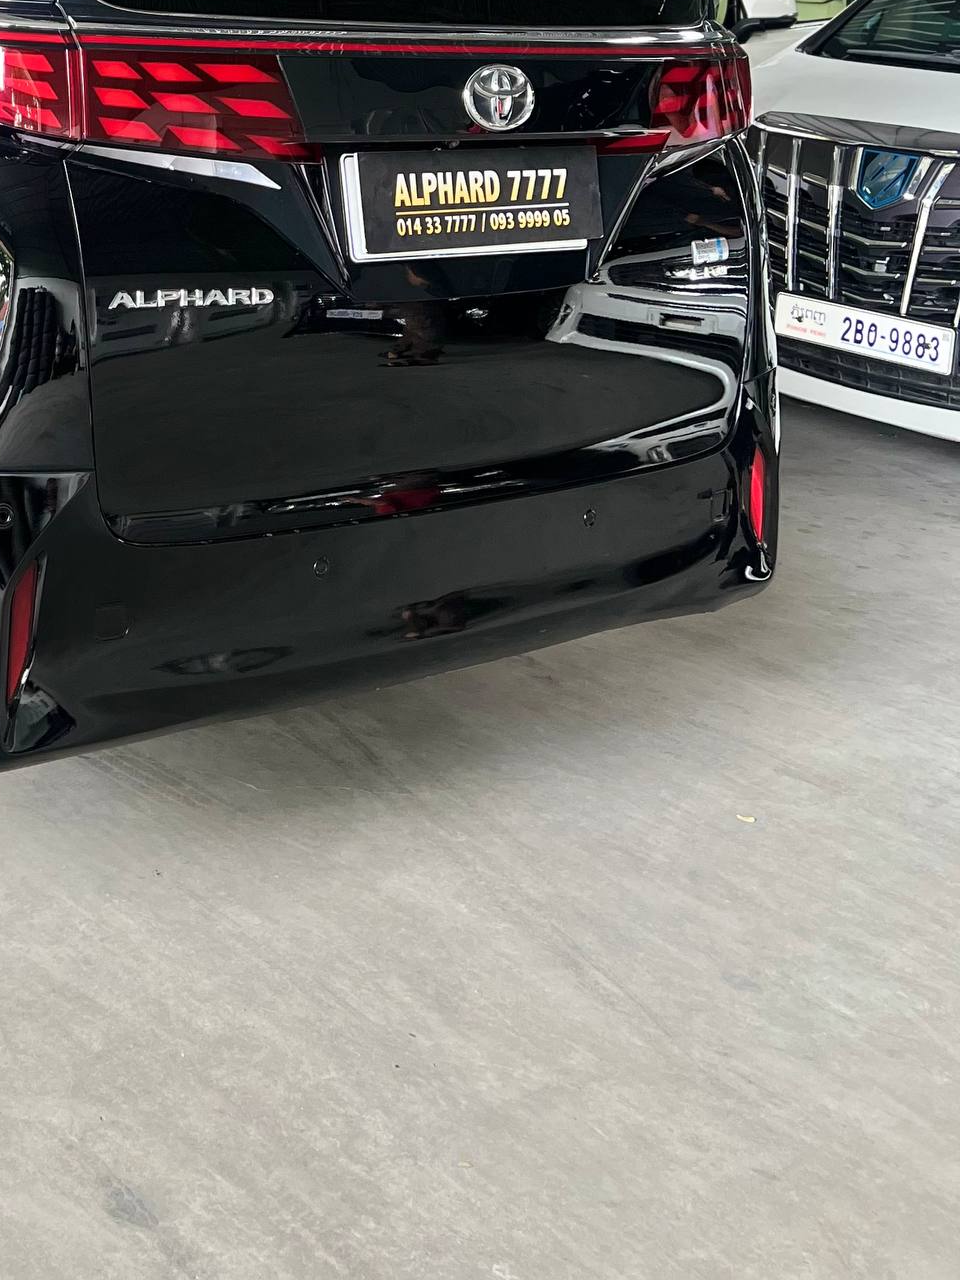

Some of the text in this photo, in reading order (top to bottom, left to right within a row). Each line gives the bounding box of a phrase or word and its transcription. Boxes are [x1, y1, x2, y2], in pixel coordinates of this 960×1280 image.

[394, 167, 568, 208] ALPHARD 7777
[396, 208, 571, 237] 014 33 7777 / 093 9999 05
[107, 286, 275, 310] ALPHARD
